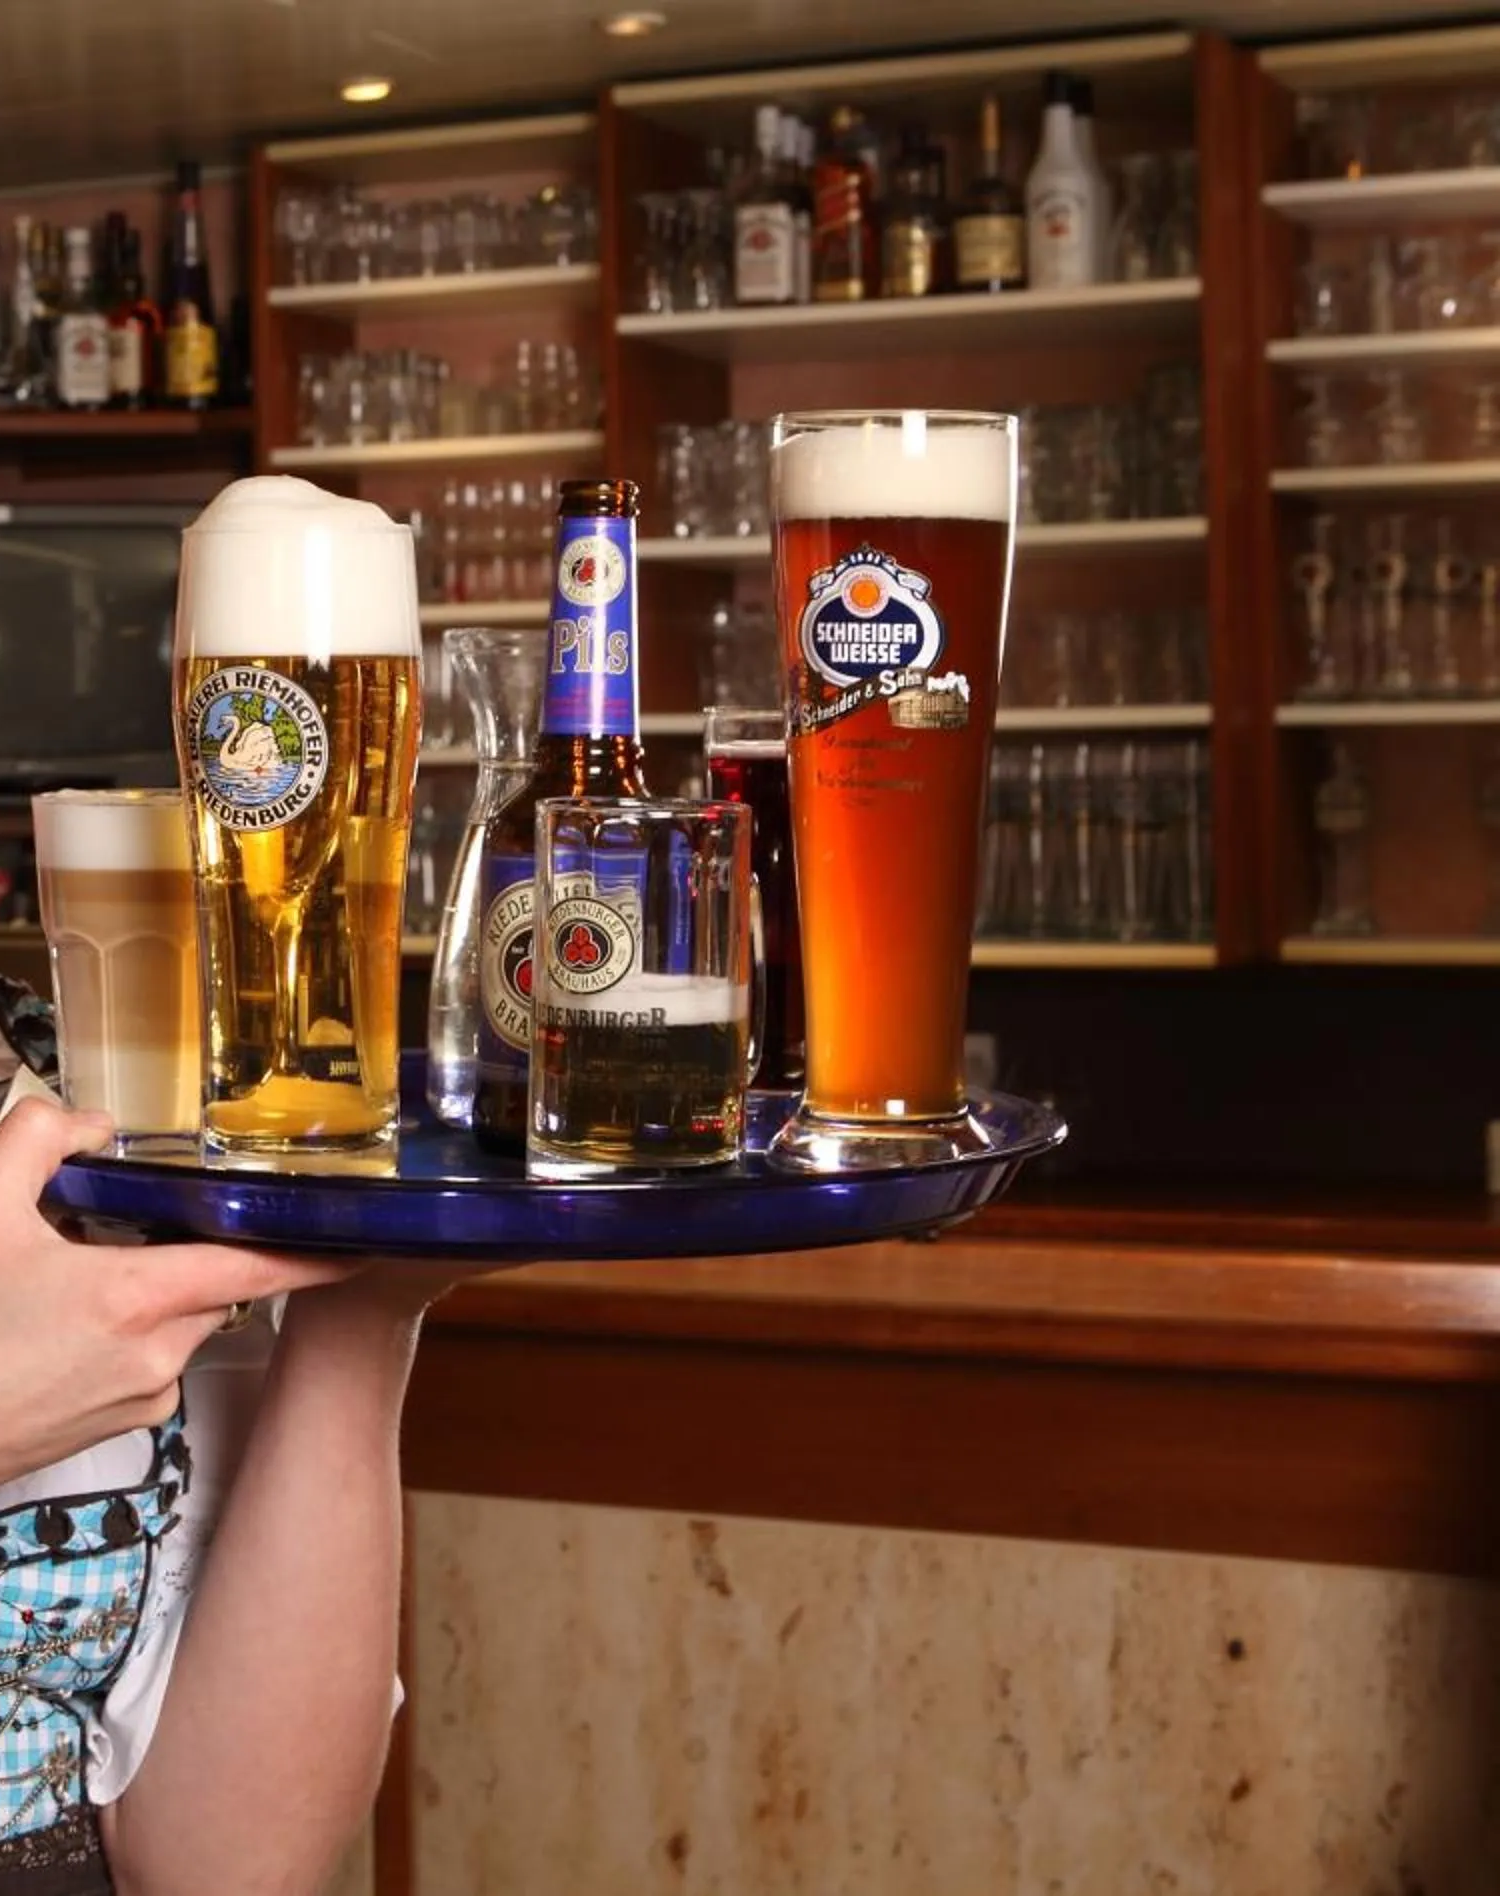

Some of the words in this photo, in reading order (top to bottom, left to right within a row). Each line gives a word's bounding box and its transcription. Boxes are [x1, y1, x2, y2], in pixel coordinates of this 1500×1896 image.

[816, 621, 917, 644] SCHNEIDER
[830, 643, 901, 665] WEISSE
[235, 671, 323, 767] RIEMHOFER
[801, 689, 861, 727] Schneider
[864, 682, 875, 698] &
[198, 778, 312, 827] RIEDENBURG
